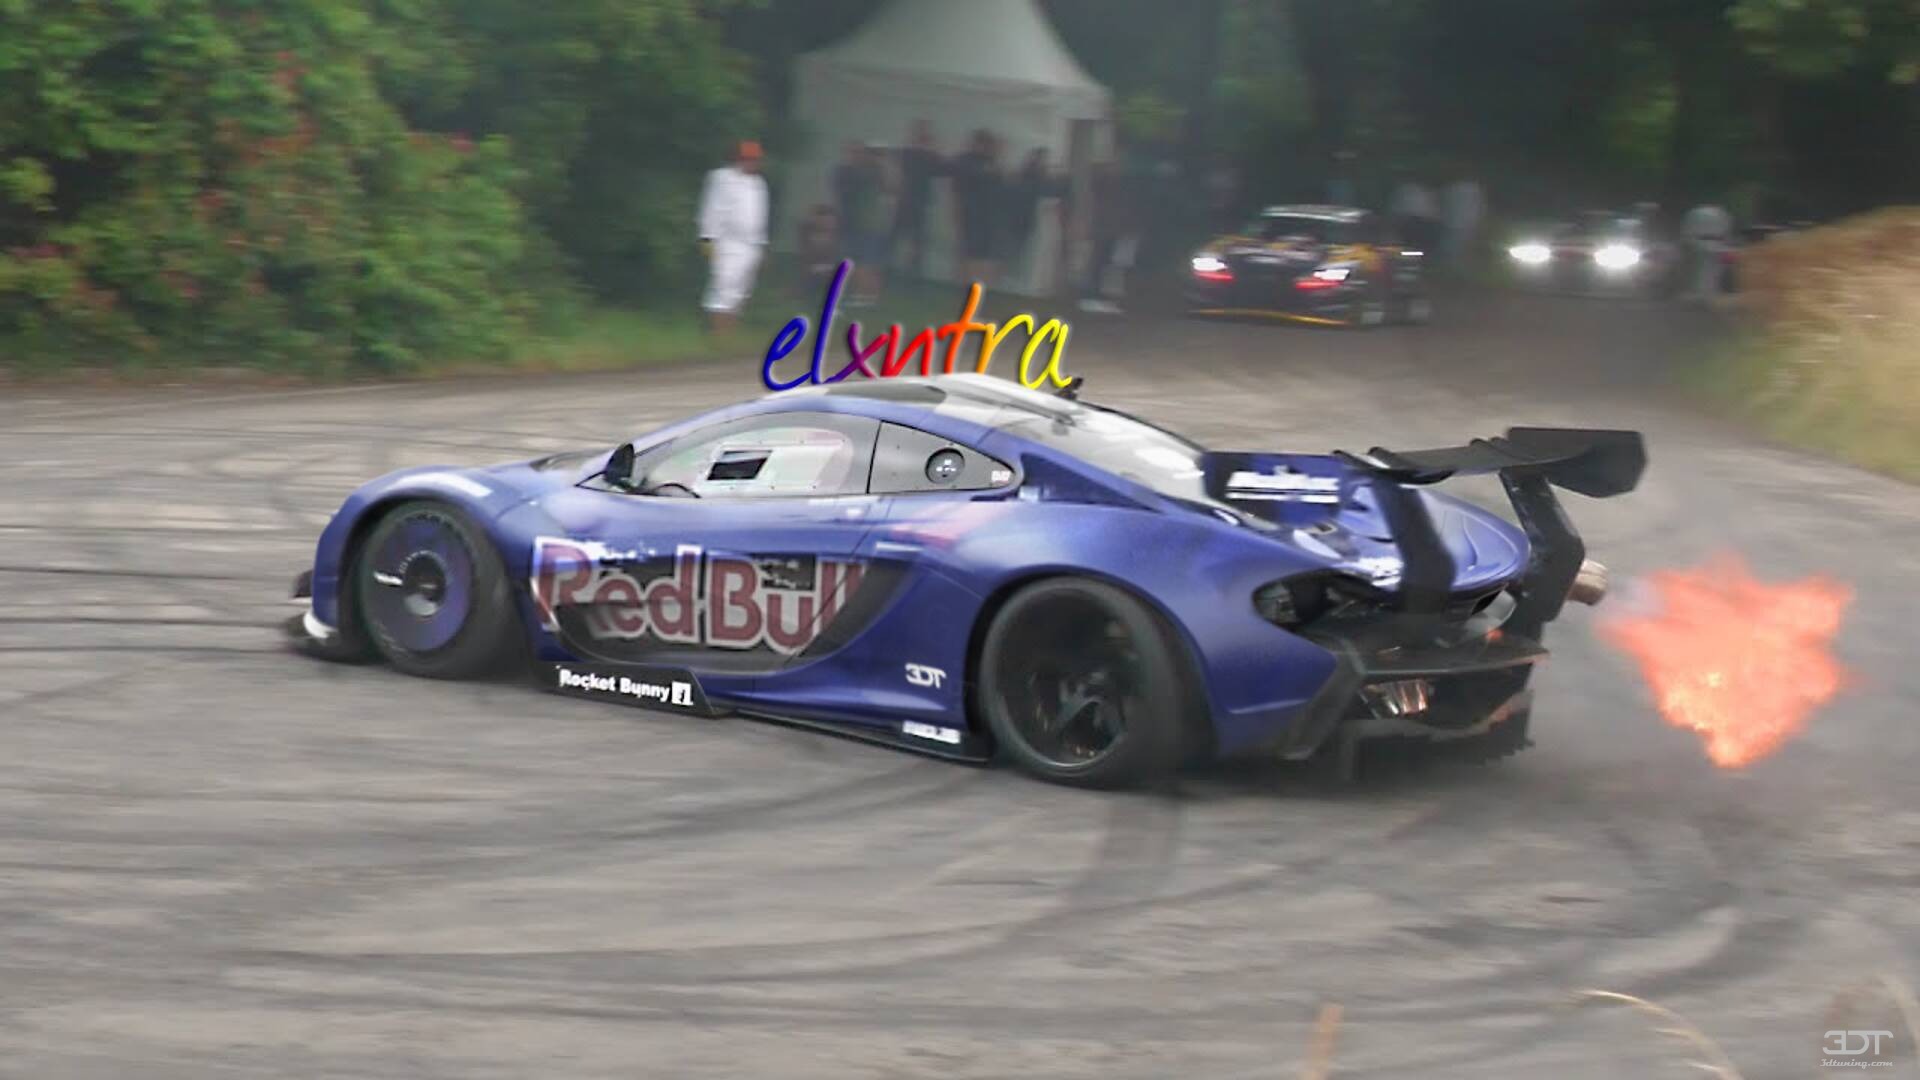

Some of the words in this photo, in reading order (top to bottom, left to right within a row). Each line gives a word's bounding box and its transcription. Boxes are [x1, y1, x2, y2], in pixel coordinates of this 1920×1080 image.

[531, 536, 704, 643] Red
[559, 669, 617, 692] Rocket
[619, 677, 670, 703] Bunny
[905, 663, 946, 688] 3DT
